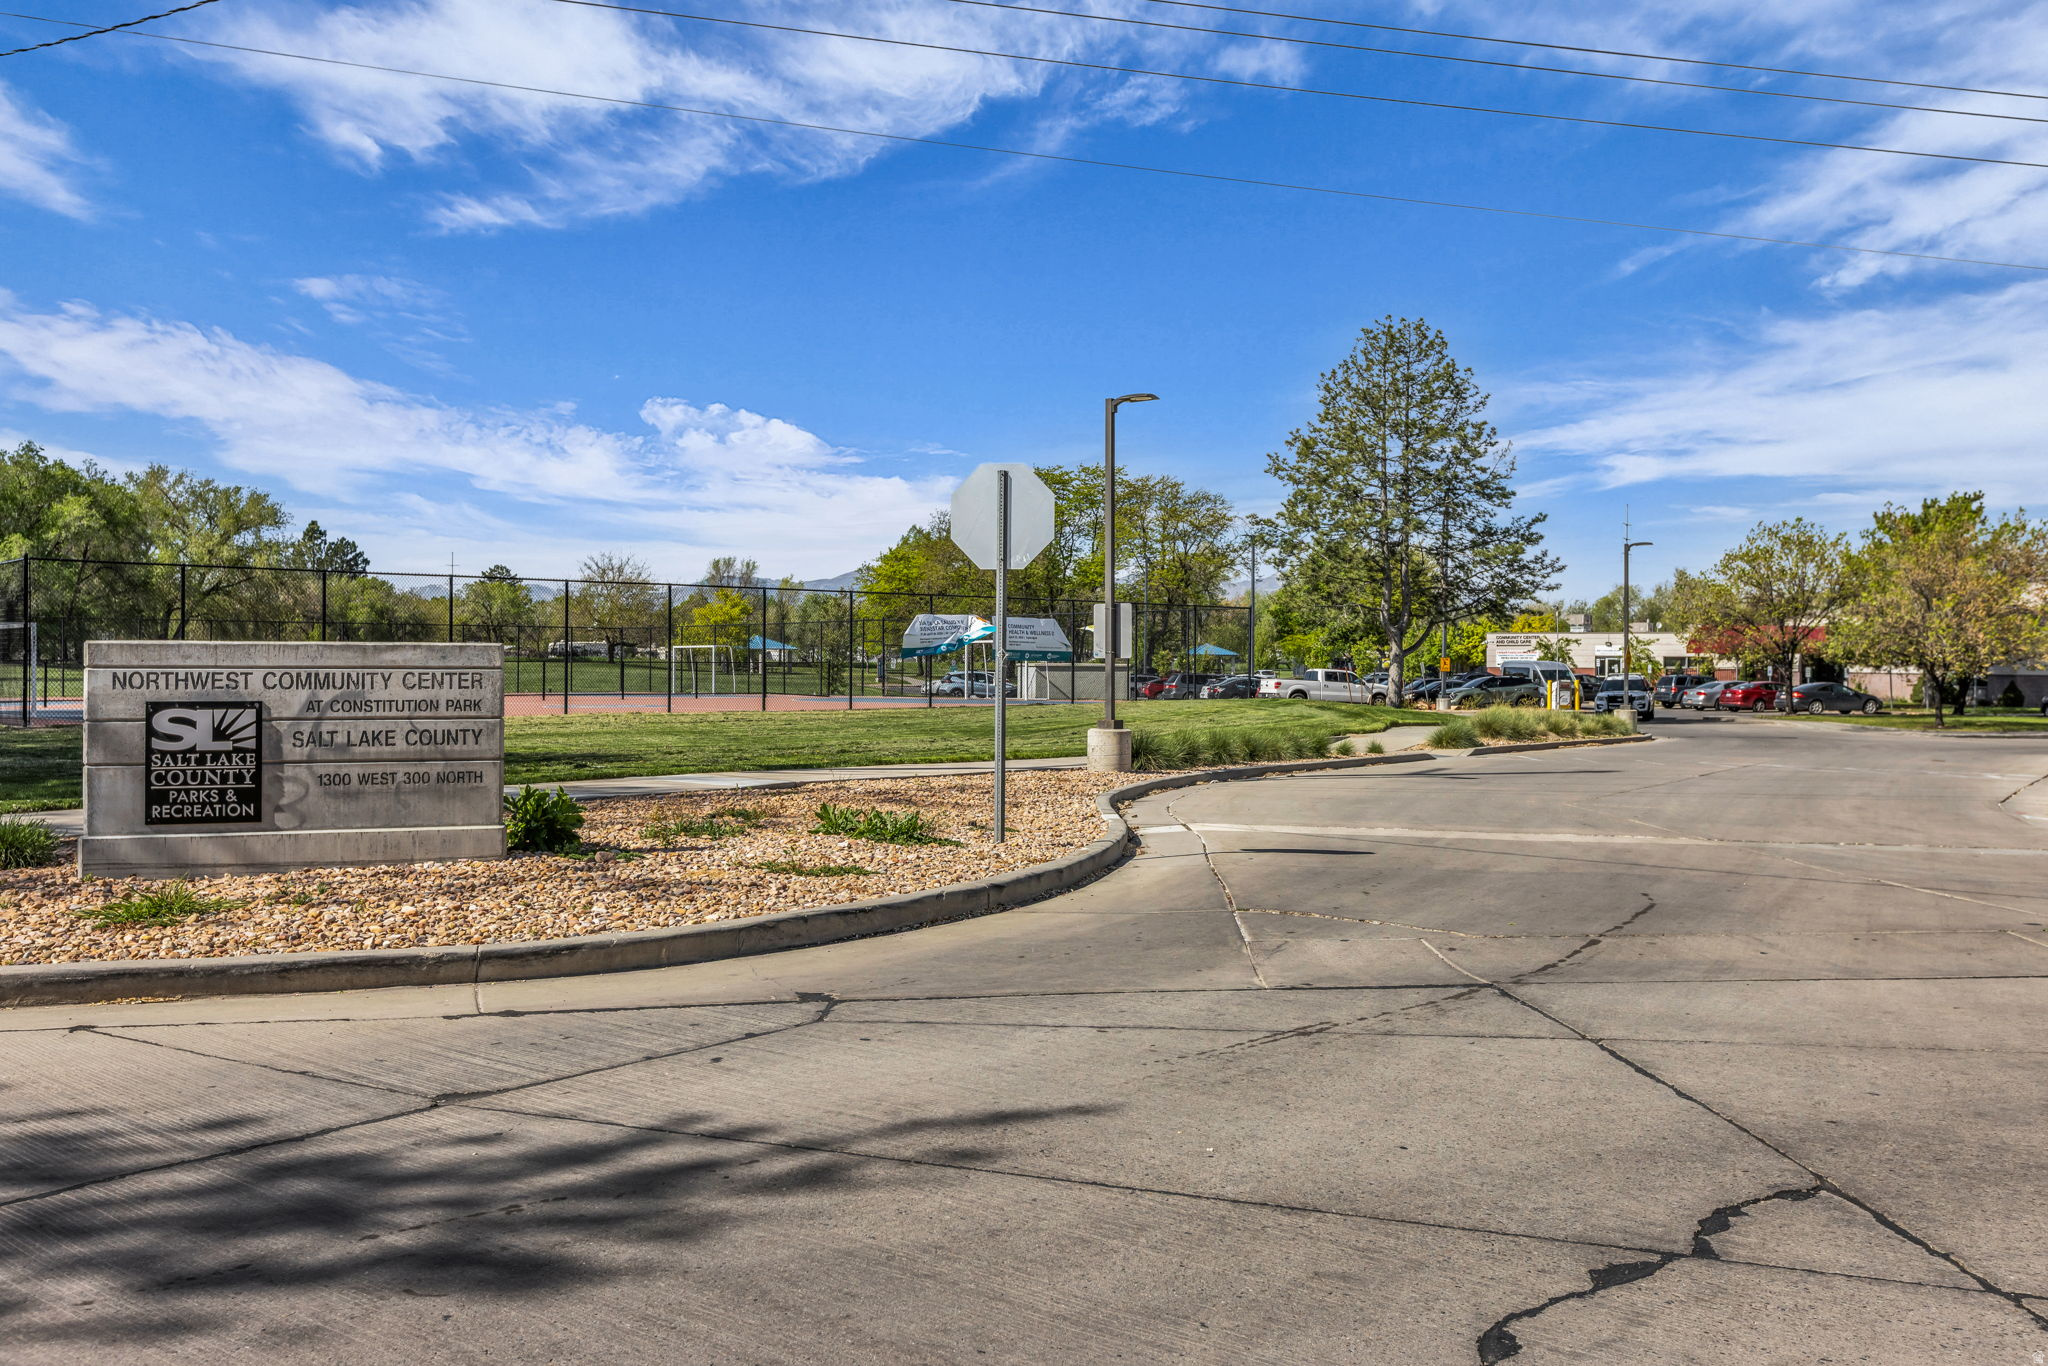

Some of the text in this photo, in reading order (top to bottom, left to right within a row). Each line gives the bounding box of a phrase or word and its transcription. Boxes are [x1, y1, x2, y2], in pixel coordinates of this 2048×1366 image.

[112, 671, 483, 690] NORTHWEST COMMUNITY CENTER
[306, 699, 482, 713] AT CONSTITUTION PARK
[292, 729, 483, 748] SALT LAKE COUNTY
[151, 753, 256, 767] SALT LAKE
[150, 769, 256, 786] COUNTY
[318, 771, 483, 787] 1300 WEST 300 NORTH
[169, 789, 237, 803] PARKS &
[152, 803, 254, 818] RECREATION
